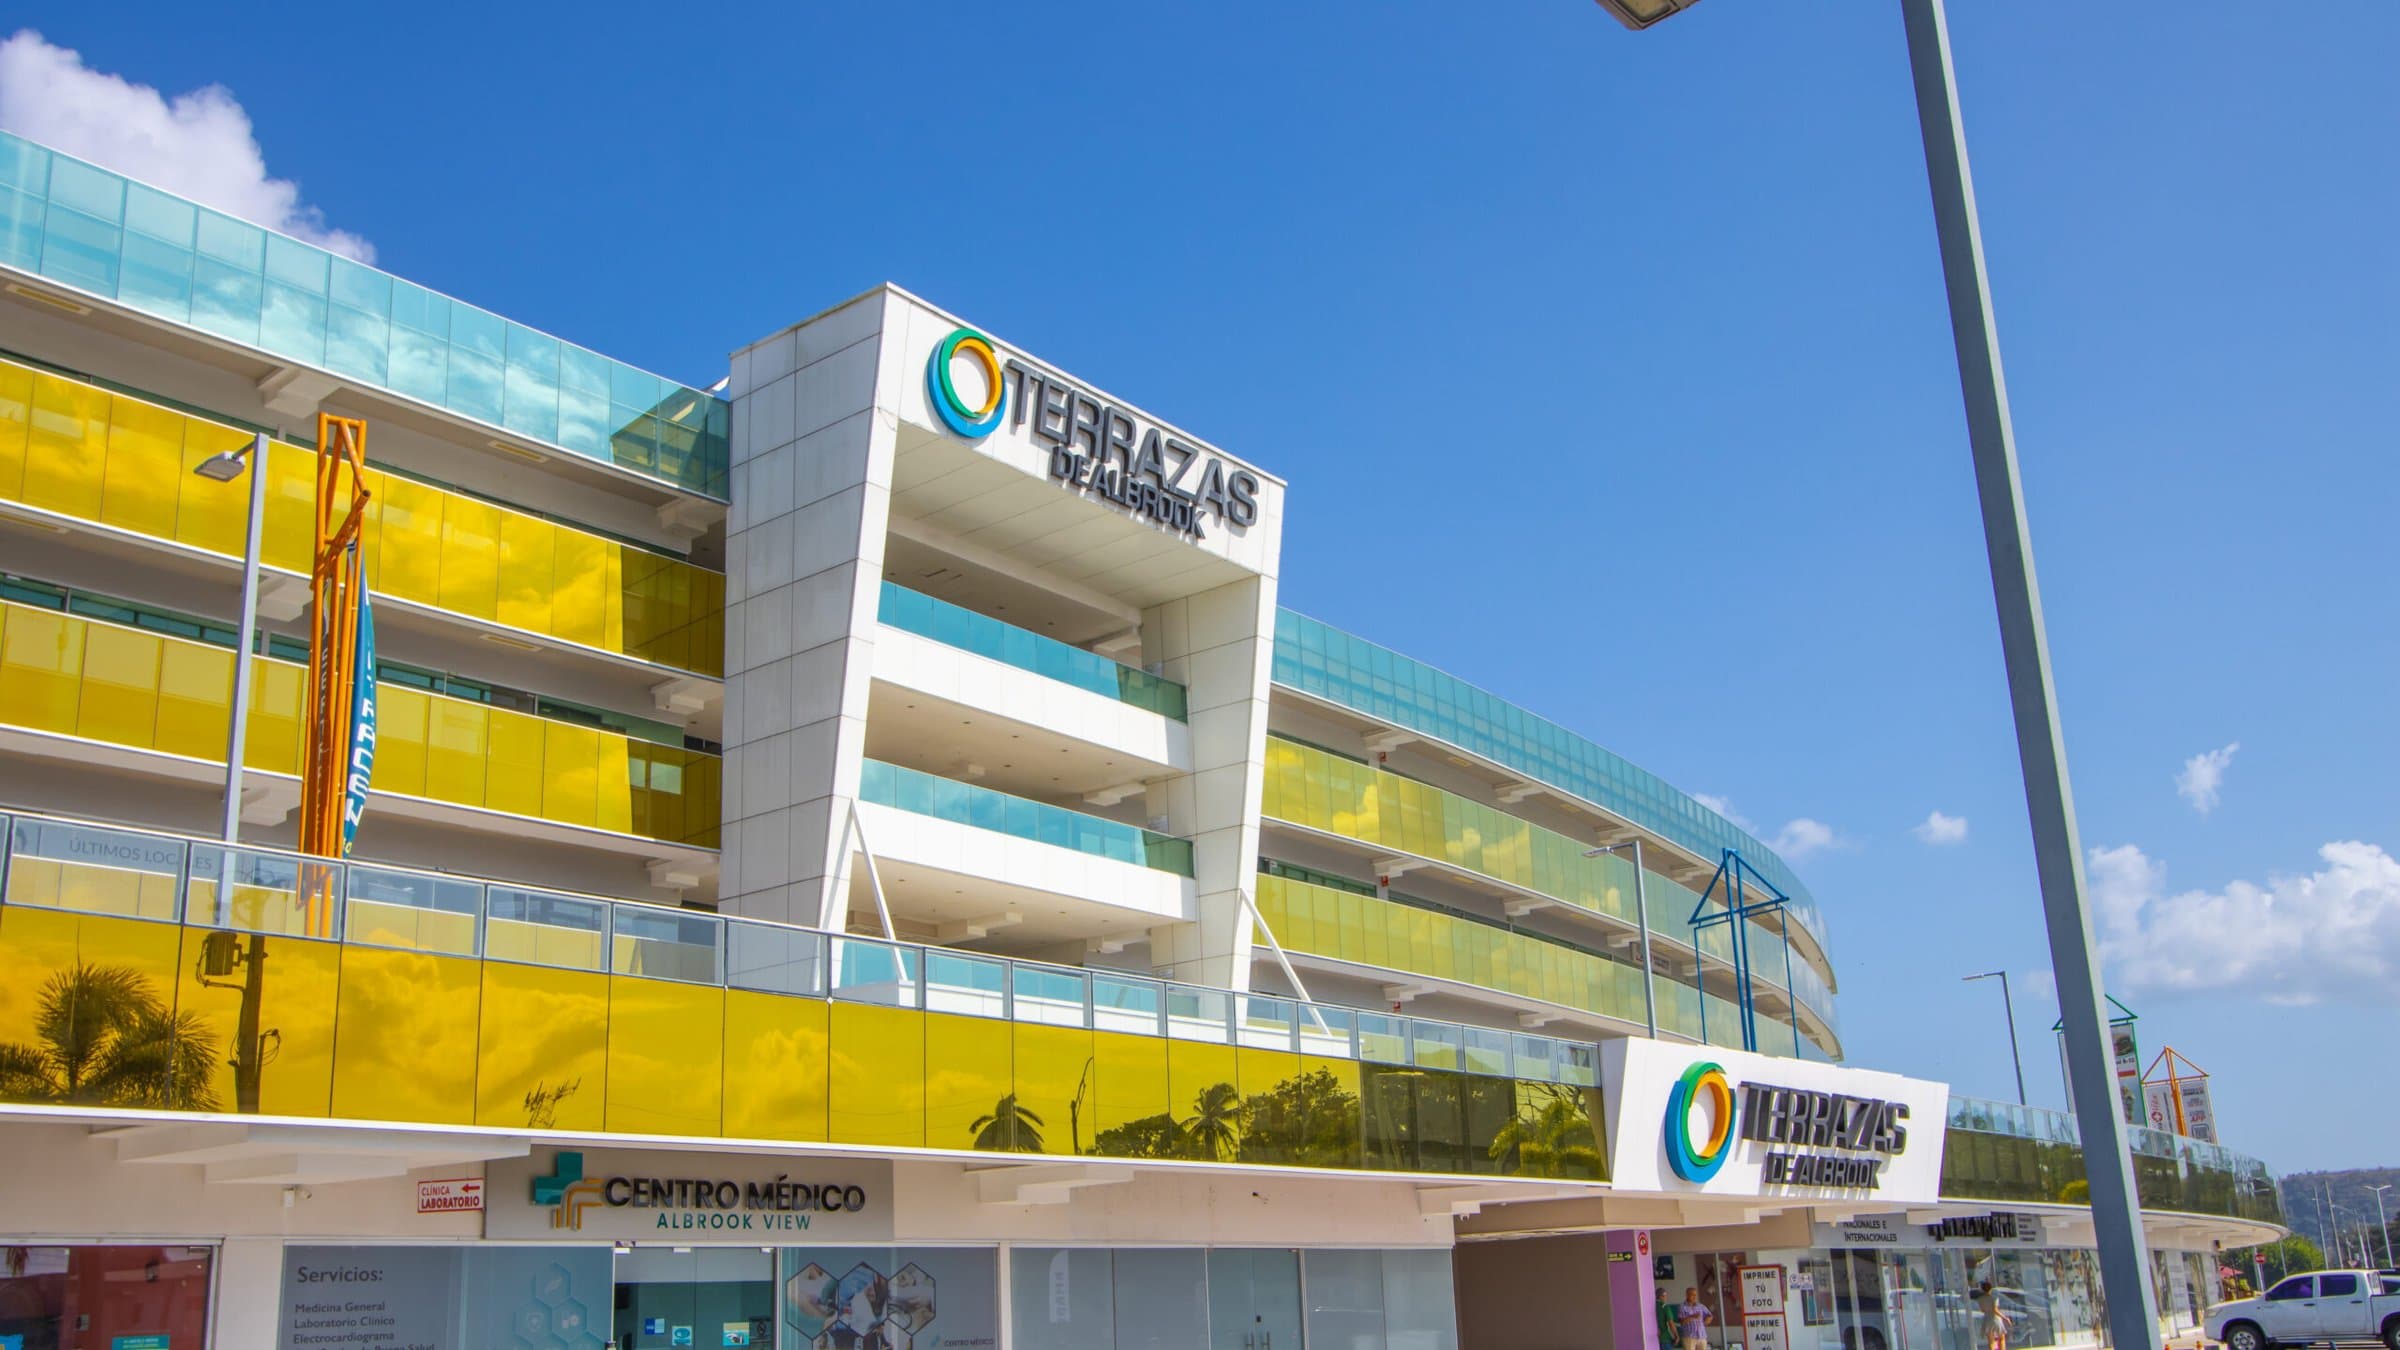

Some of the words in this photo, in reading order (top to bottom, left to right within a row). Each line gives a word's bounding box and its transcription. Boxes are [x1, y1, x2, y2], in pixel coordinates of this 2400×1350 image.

[1006, 358, 1259, 528] TERRAZAS
[1051, 445, 1091, 489] DE
[1087, 464, 1206, 539] ALBROOK
[69, 837, 140, 861] ÚLTIMOS
[1740, 1080, 1910, 1155] TERRAZAS
[1766, 1152, 1795, 1186] DE
[1790, 1155, 1882, 1190] ALBROOK
[421, 1184, 450, 1197] CLÍNICA
[604, 1176, 740, 1211] CENTRO
[746, 1174, 866, 1212] MÉDICO
[421, 1195, 480, 1209] LABORATORIO
[656, 1212, 753, 1230] ALBROOK
[763, 1213, 812, 1231] VIEW
[1844, 1231, 1898, 1243] INTERNACIONALES
[297, 1266, 384, 1283] Servicios:
[1743, 1270, 1777, 1281] IMPRIME
[295, 1303, 342, 1314] Medicina
[345, 1301, 386, 1313] General
[1752, 1298, 1773, 1308] FOTO
[294, 1318, 357, 1330] Laboratorio
[1747, 1318, 1781, 1329] IMPRIME
[293, 1331, 395, 1345] Electrocardiograma
